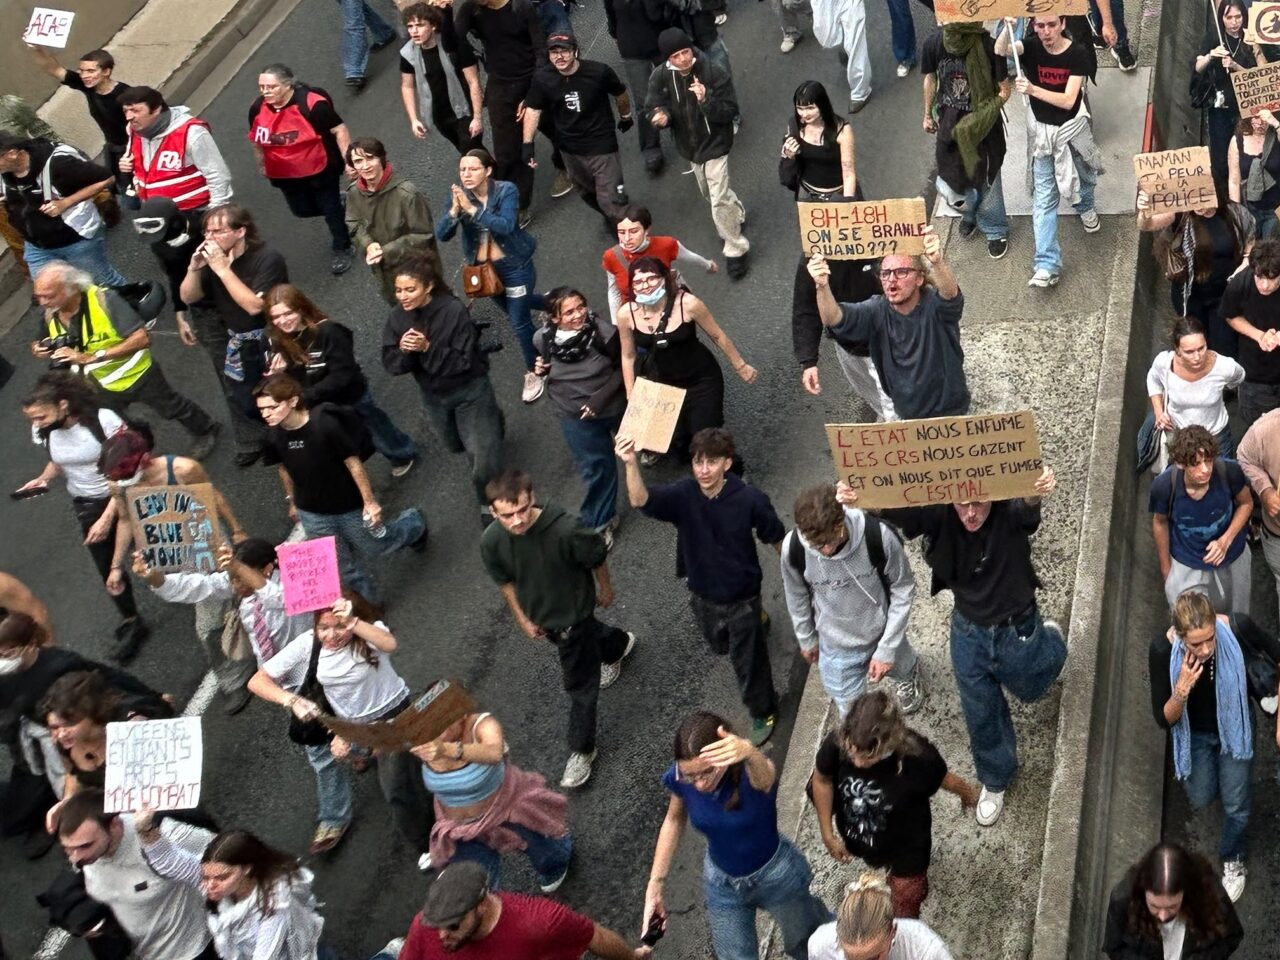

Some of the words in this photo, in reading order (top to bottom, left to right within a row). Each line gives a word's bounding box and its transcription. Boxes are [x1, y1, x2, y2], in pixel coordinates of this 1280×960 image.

[28, 13, 68, 37] ACAB
[1236, 80, 1259, 91] THAT
[1138, 151, 1191, 170] MAMAN
[1168, 165, 1205, 179] PEUR
[810, 205, 887, 228] 8H-18H
[807, 229, 832, 244] ON
[838, 227, 862, 241] SE
[872, 222, 927, 238] BRANLE
[916, 421, 962, 441] NOUS
[965, 414, 1026, 435] ENFUME
[842, 451, 879, 468] LES
[884, 450, 920, 466] CRS
[923, 446, 965, 462] NOUS
[968, 440, 1026, 457] GAZENT
[848, 473, 865, 489] ET
[872, 473, 894, 487] ON
[899, 470, 933, 485] NOUS
[966, 464, 996, 477] QUE
[1000, 458, 1043, 475] FUMER
[903, 482, 954, 504] C'EST
[956, 479, 990, 501] MAL
[174, 493, 190, 514] IN
[144, 522, 183, 545] BLUE
